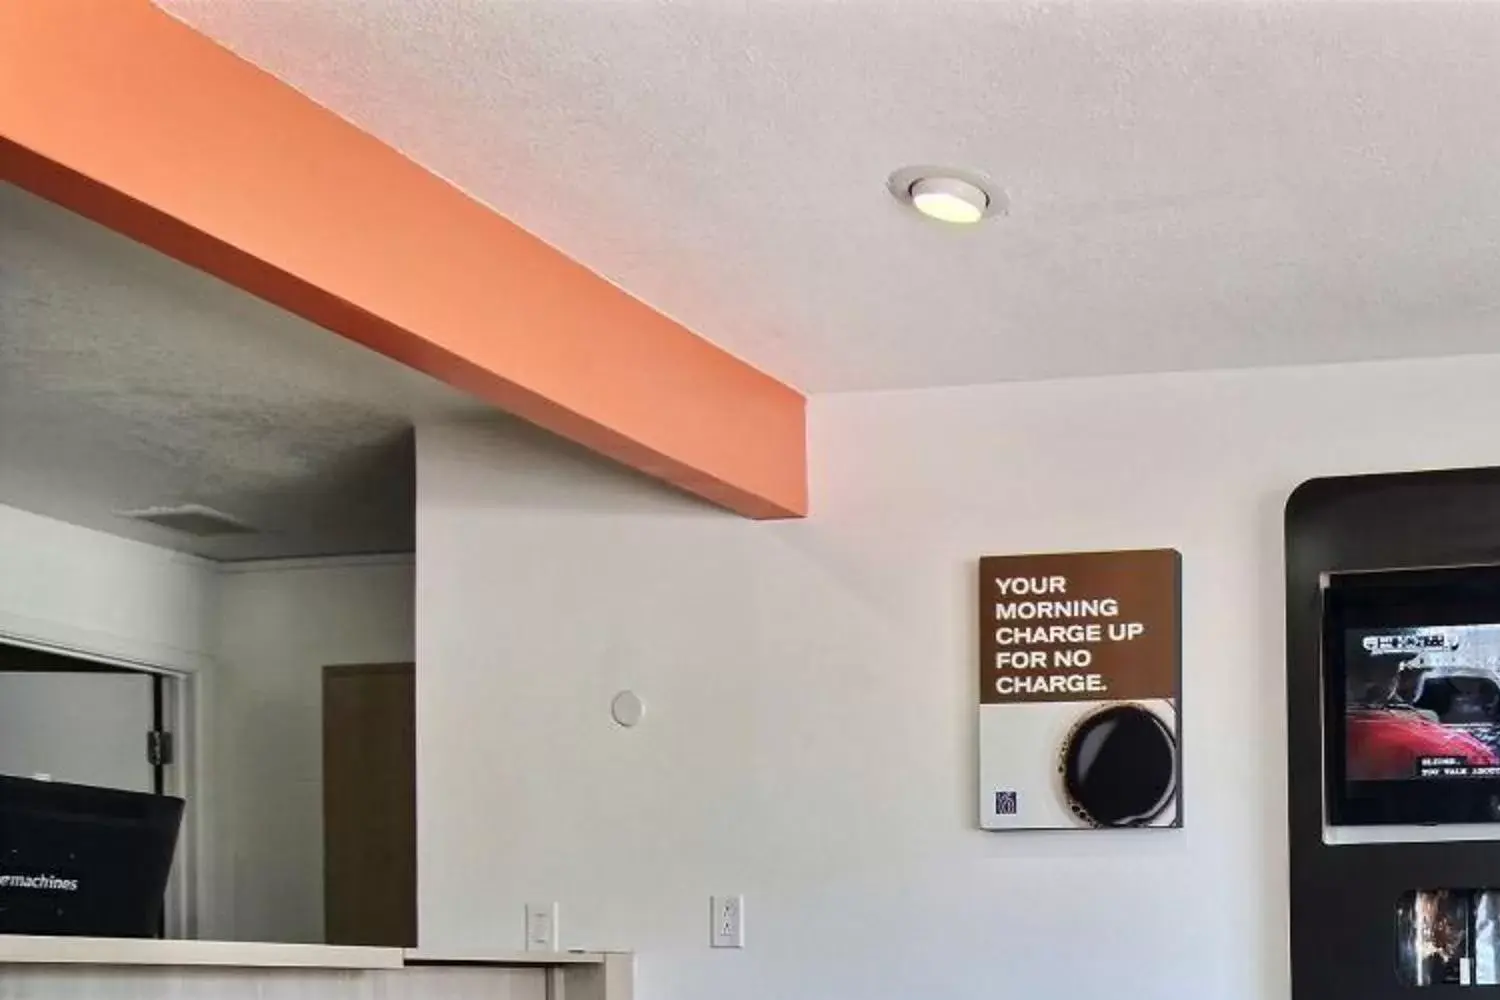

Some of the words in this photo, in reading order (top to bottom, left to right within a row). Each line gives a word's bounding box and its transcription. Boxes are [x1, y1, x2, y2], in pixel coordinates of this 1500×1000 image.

[995, 576, 1067, 595] YOUR
[995, 599, 1119, 621] MORNING
[995, 624, 1102, 645] CHARGE
[1108, 623, 1144, 641] UP
[995, 651, 1047, 669] FOR
[1053, 650, 1092, 667] NO
[995, 674, 1108, 694] CHARGE.
